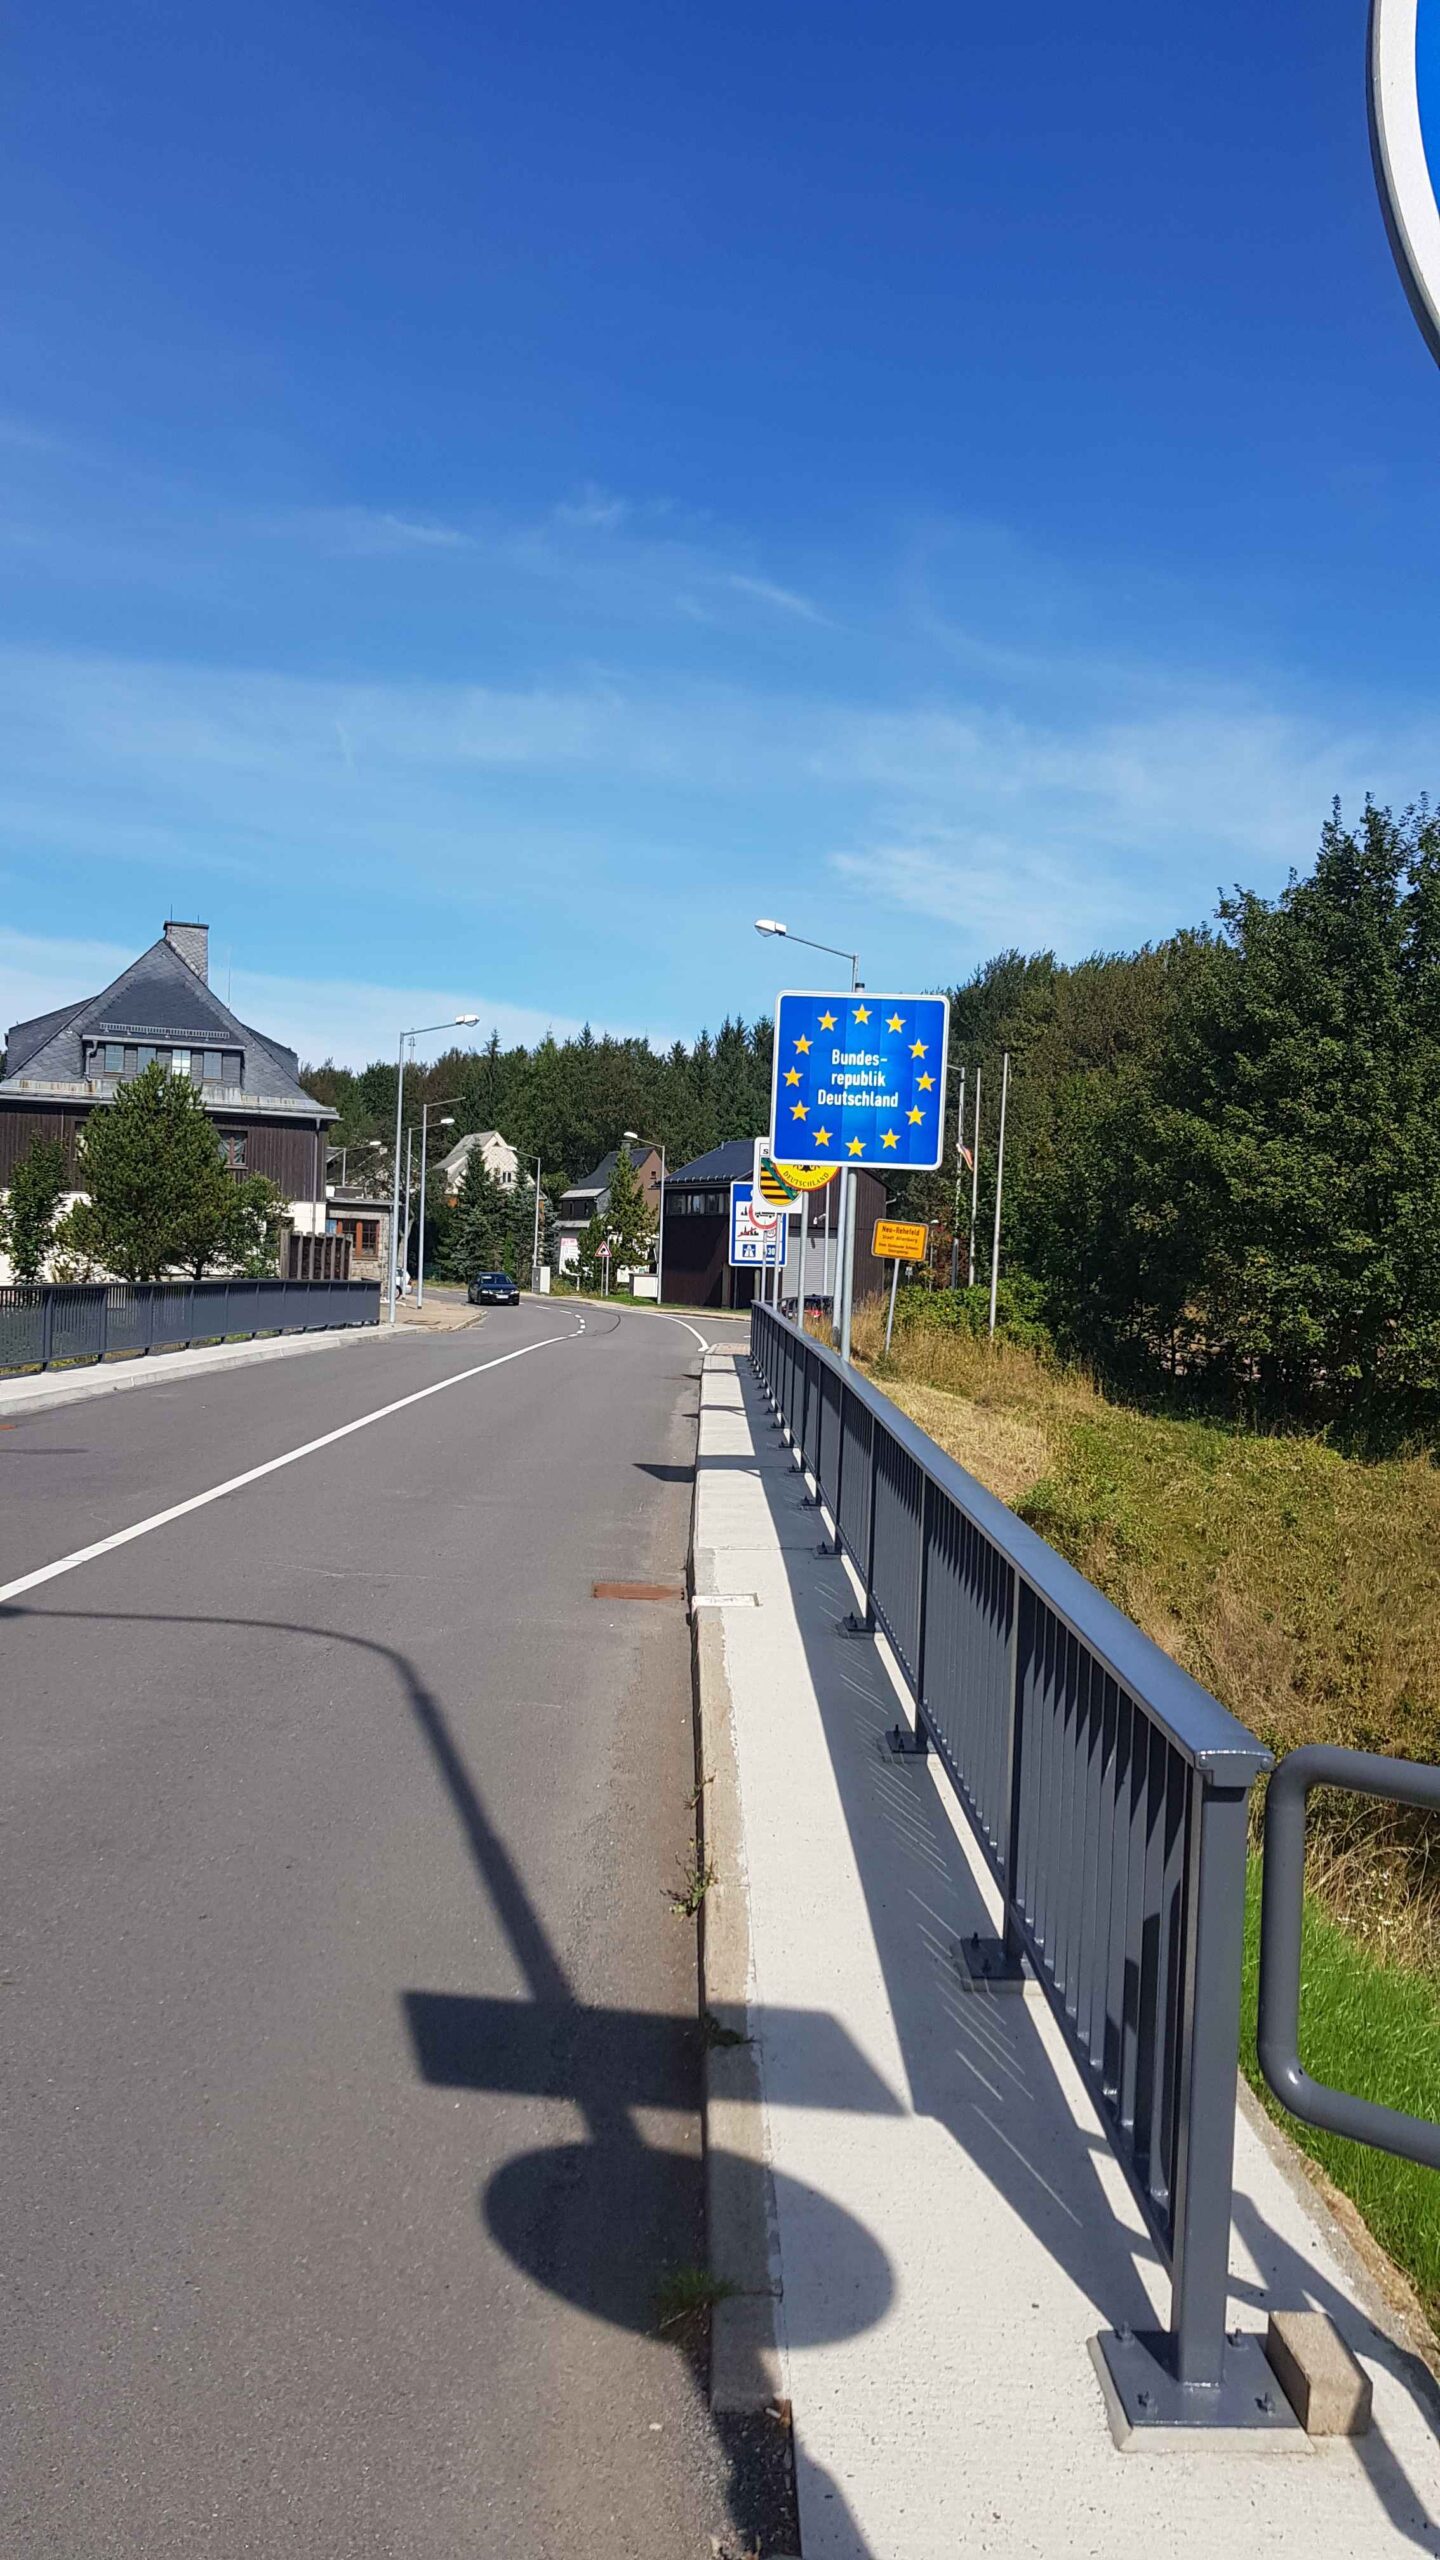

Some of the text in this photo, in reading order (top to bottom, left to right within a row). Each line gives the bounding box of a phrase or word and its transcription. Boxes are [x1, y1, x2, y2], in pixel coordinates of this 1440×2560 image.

[832, 1049, 888, 1066] Bundes-
[831, 1070, 886, 1090] republik
[818, 1089, 899, 1107] Deutschland
[783, 1171, 830, 1187] DEUTSCHLAND
